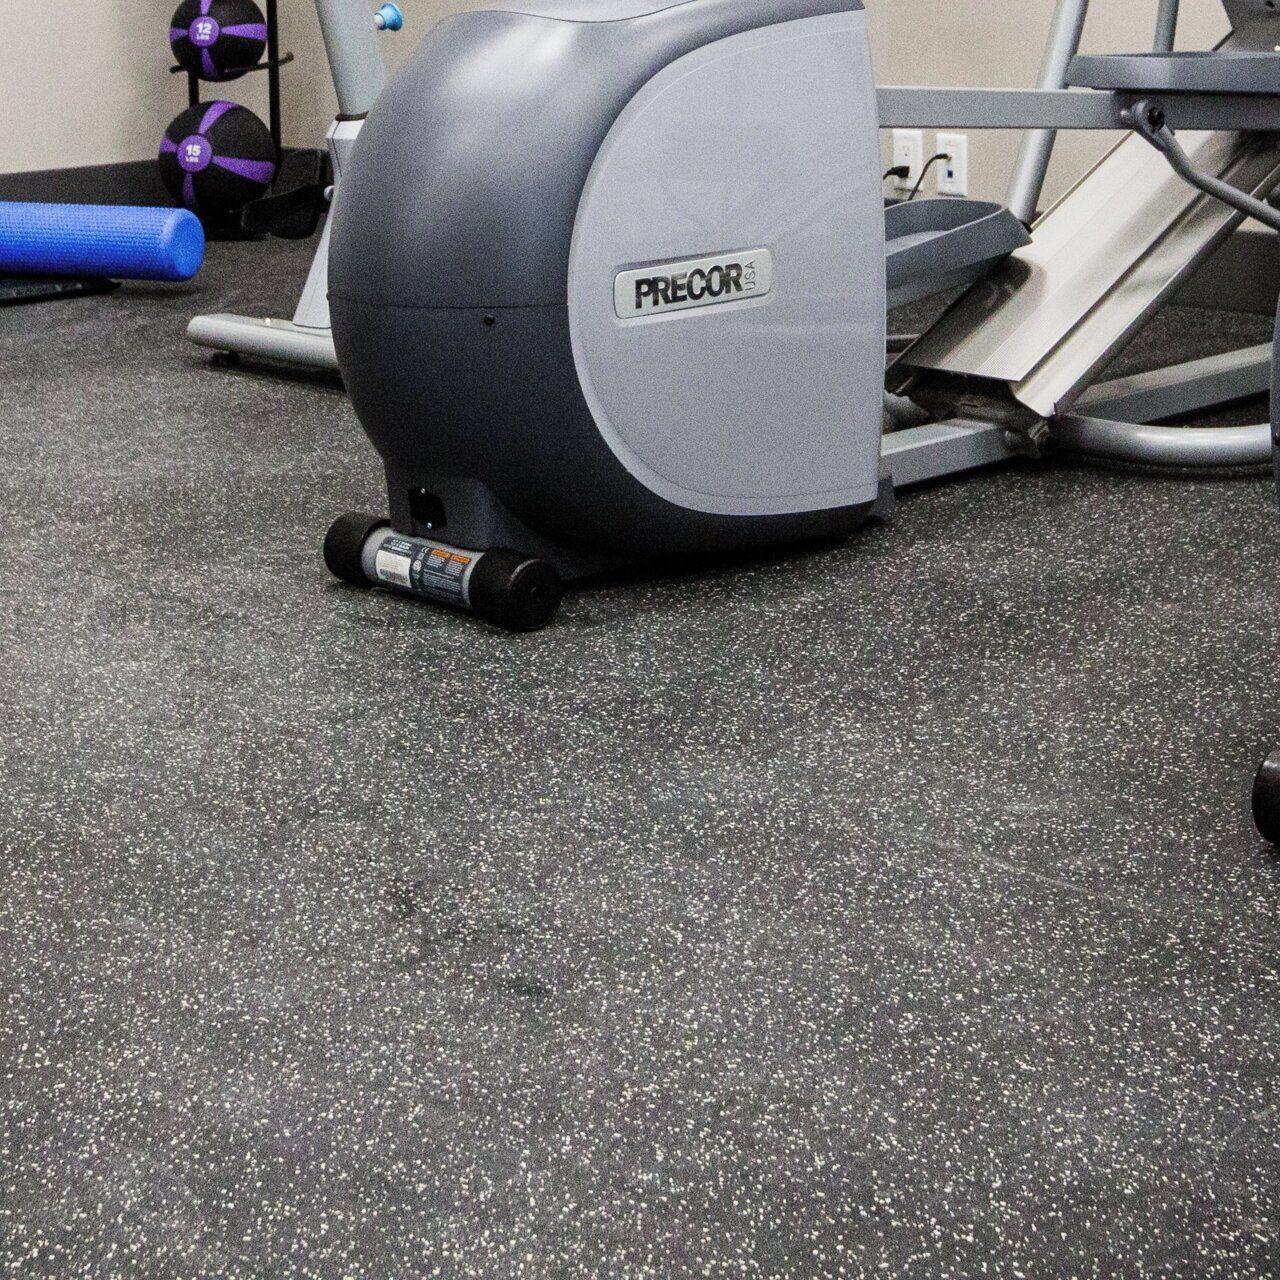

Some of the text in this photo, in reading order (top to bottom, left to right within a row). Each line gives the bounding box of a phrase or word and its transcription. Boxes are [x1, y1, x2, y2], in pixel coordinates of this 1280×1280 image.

[196, 22, 212, 34] 12
[185, 144, 201, 156] 15
[635, 263, 743, 310] PRECOR
[745, 260, 756, 292] USA
